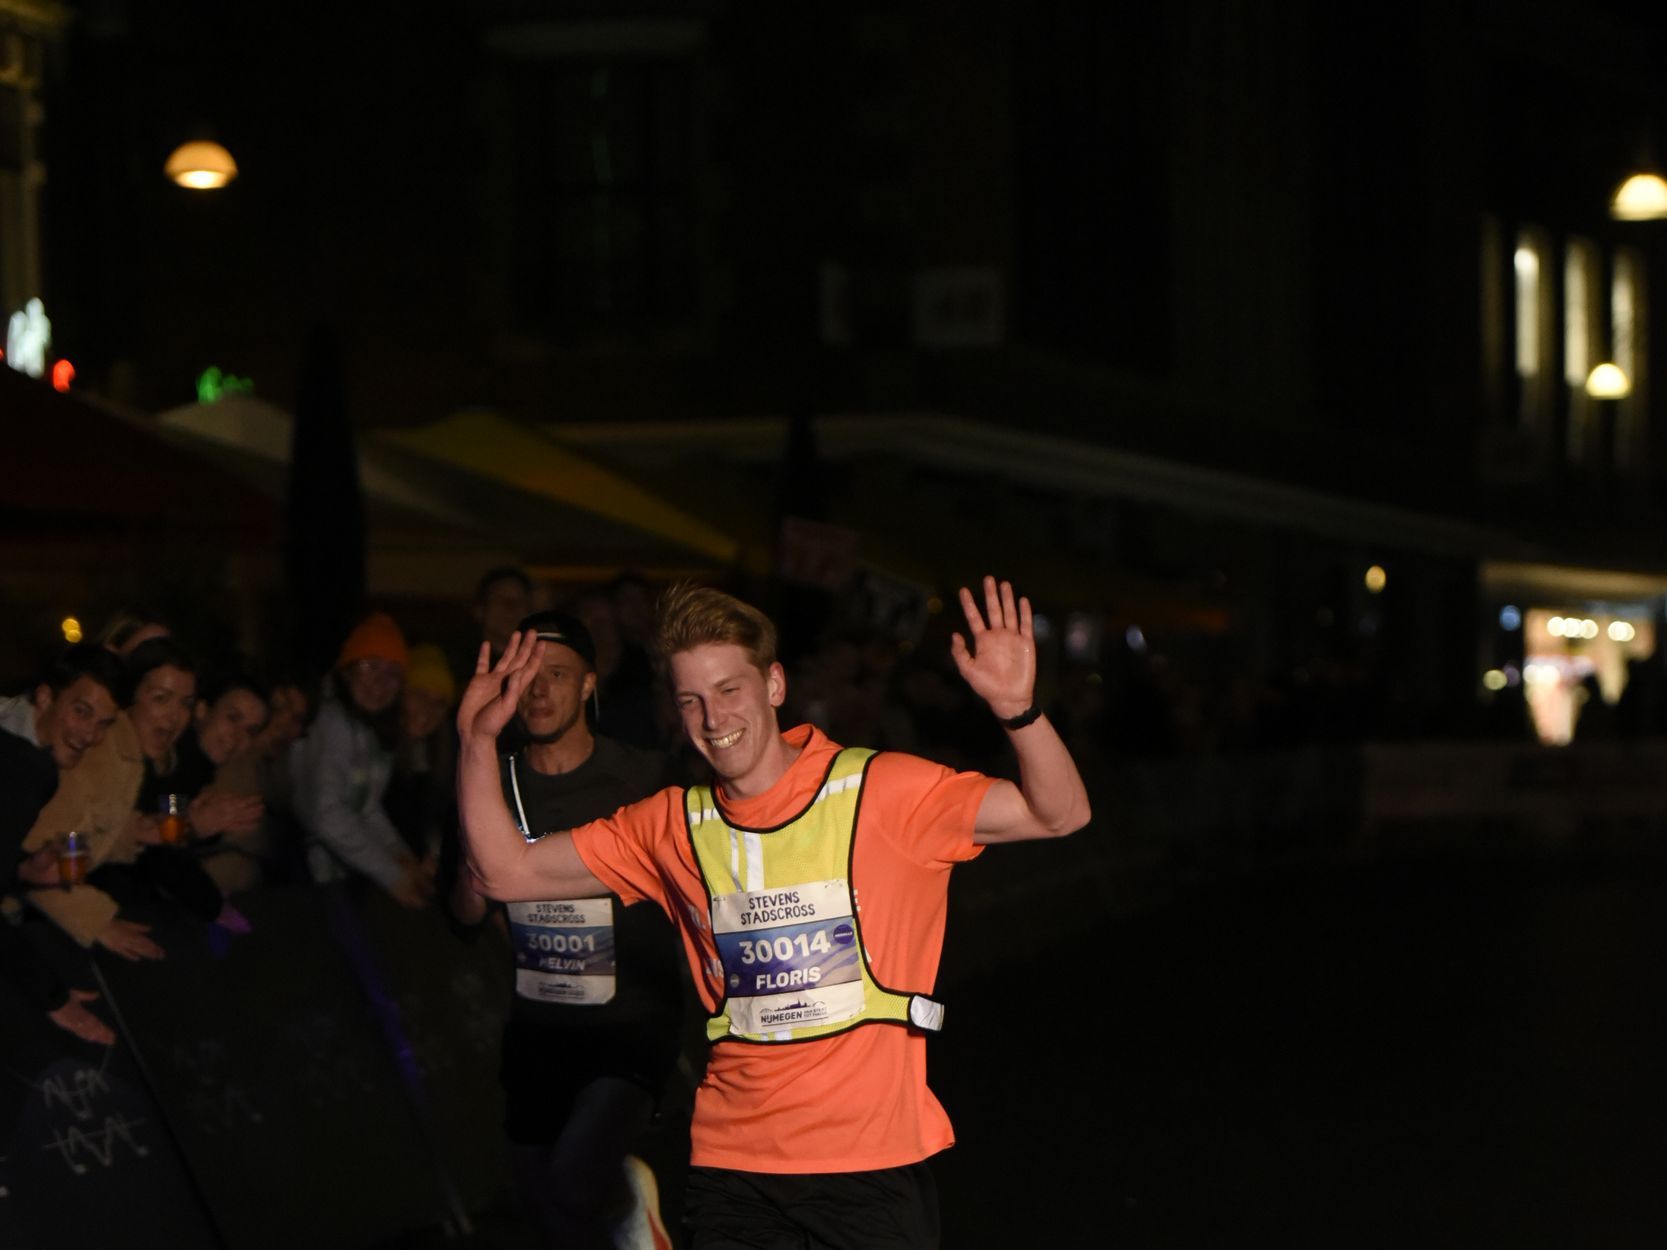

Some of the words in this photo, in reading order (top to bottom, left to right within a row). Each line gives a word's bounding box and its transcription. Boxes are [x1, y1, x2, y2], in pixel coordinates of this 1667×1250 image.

[536, 904, 576, 913] STEVENS
[748, 891, 801, 910] STEVENS
[740, 904, 816, 925] STADSCROSS
[525, 933, 595, 952] 30001
[739, 929, 832, 965] 30014
[755, 966, 822, 990] FLORIS
